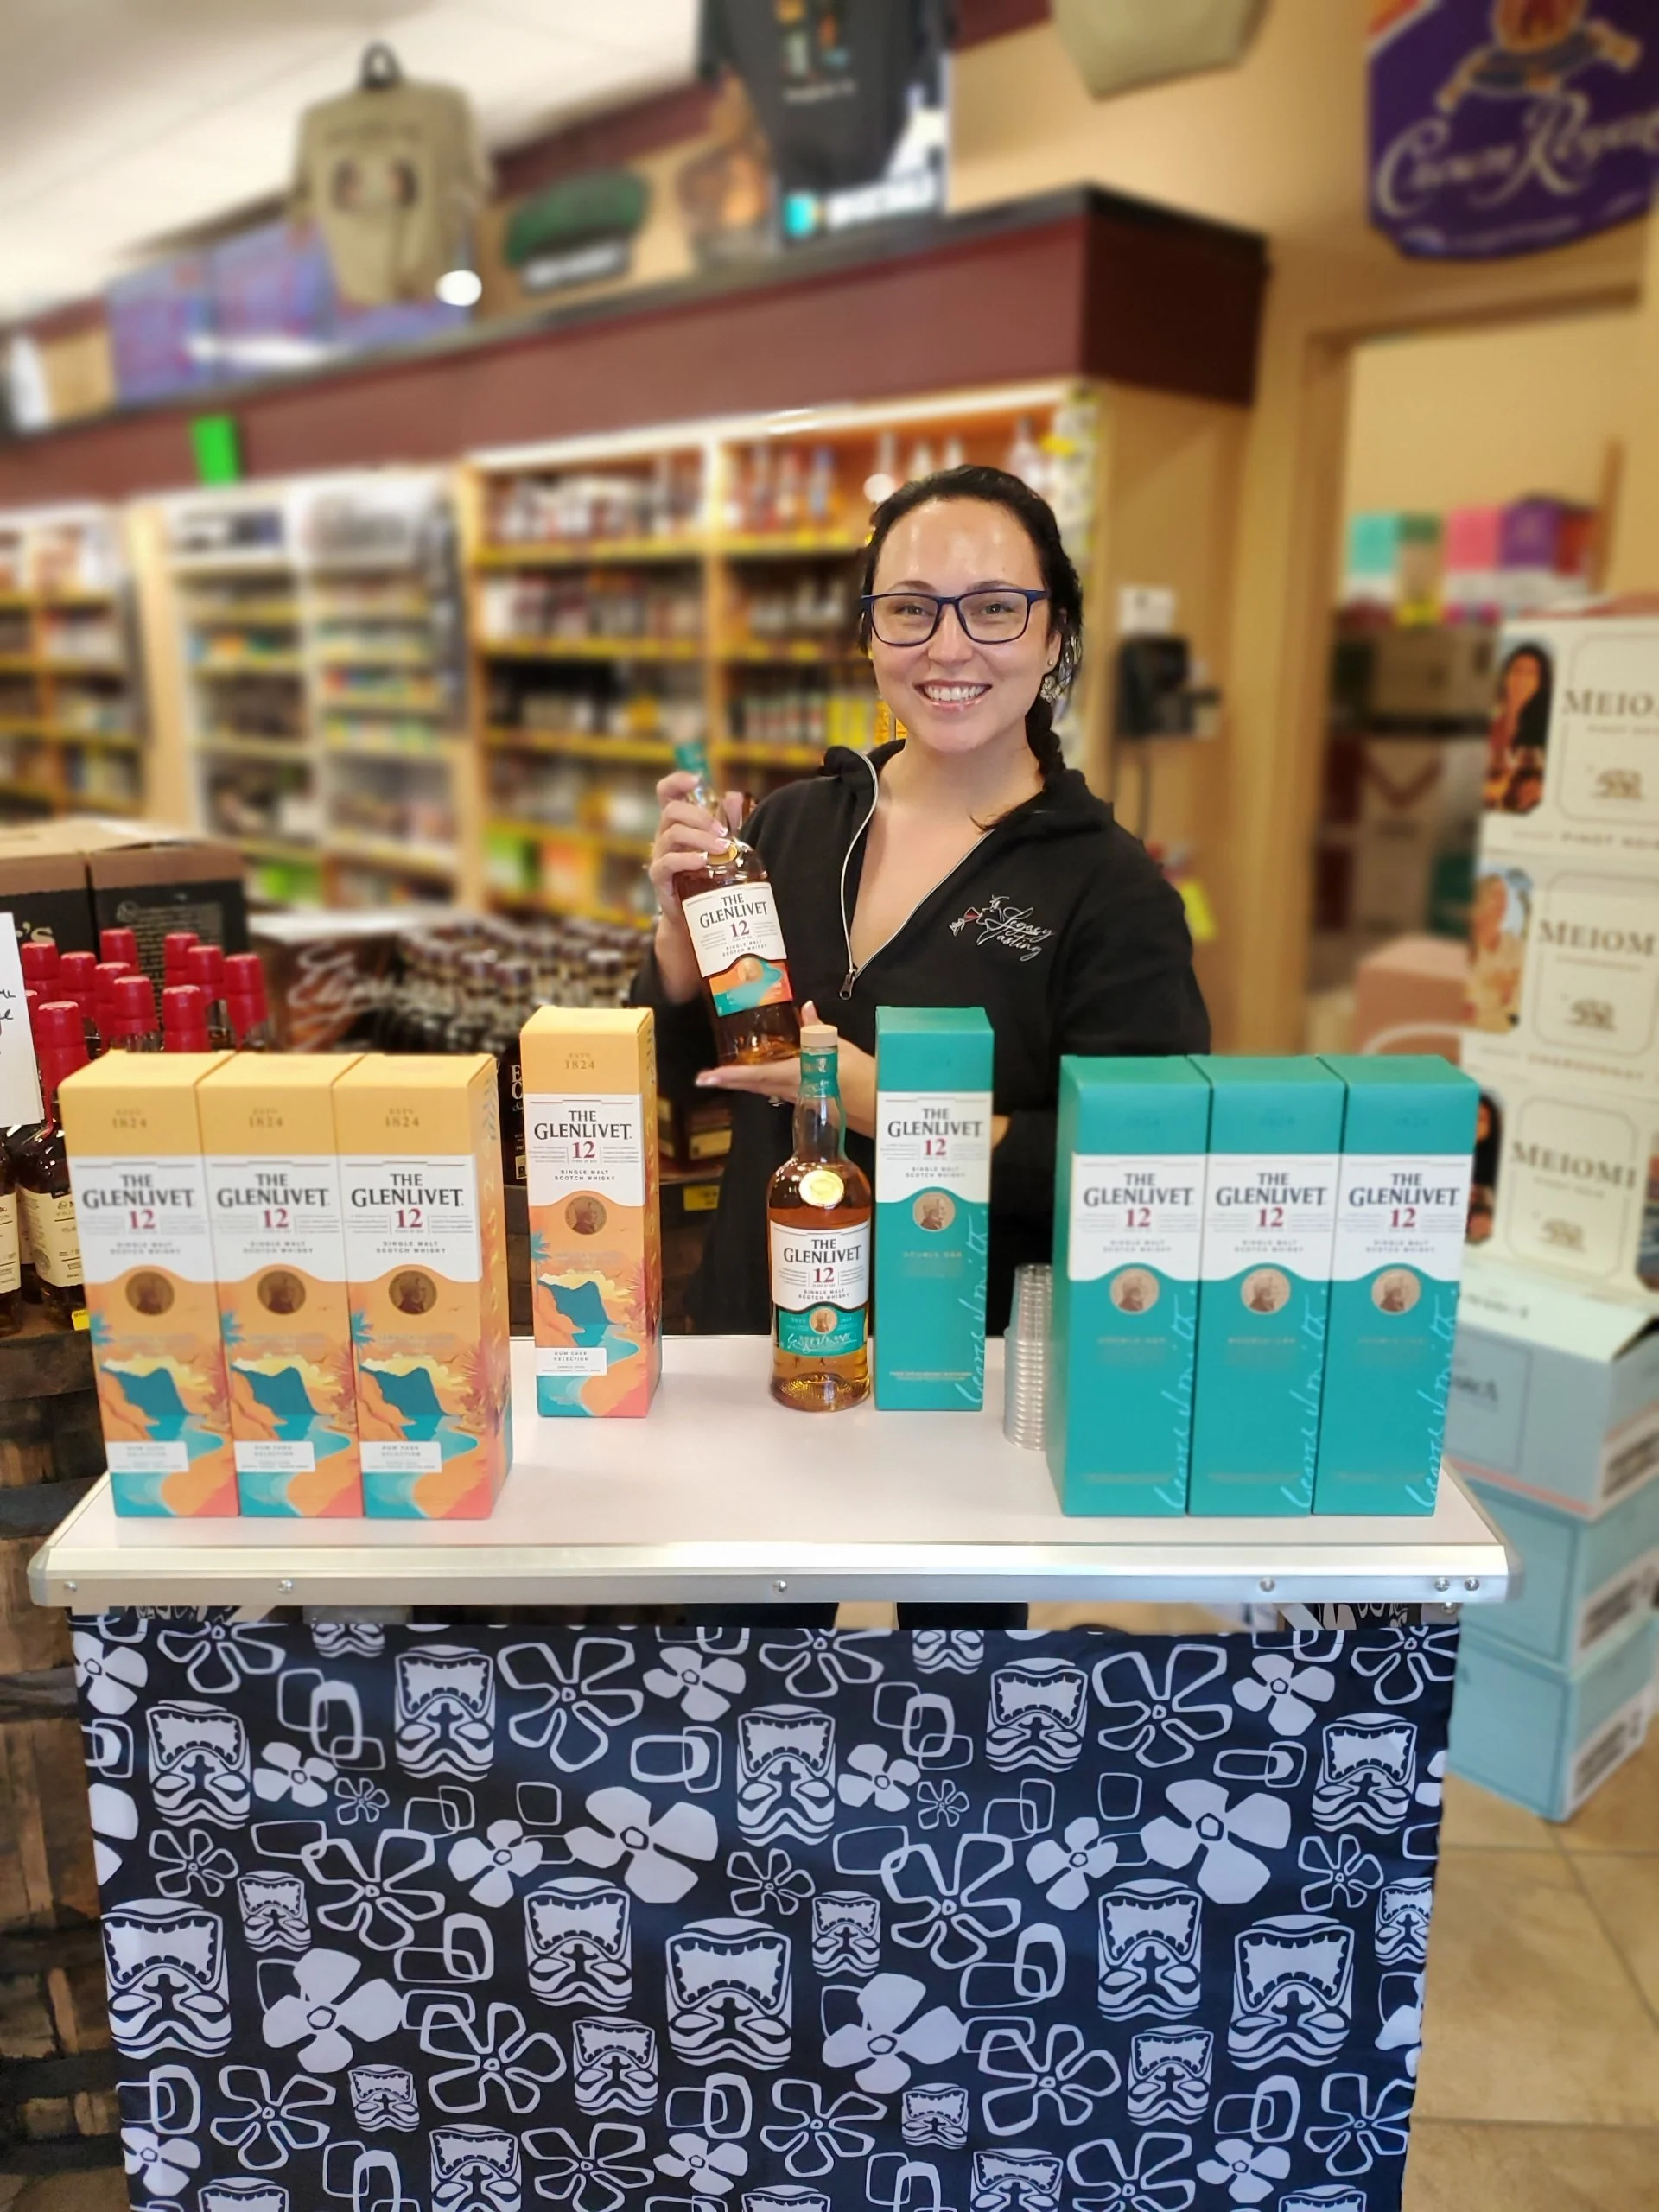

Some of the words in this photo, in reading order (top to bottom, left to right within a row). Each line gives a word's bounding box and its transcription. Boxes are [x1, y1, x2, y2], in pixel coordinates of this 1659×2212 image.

[721, 893, 744, 906] THE
[700, 901, 767, 928] GLENLIVET
[730, 920, 750, 938] 12
[1540, 919, 1655, 957] MEIOM
[565, 1059, 595, 1070] 1824
[568, 1110, 596, 1122] THE
[922, 1109, 949, 1119] THE
[572, 1141, 595, 1159] 12
[925, 1138, 947, 1156] 12
[1514, 1141, 1637, 1190] MEIOMI
[120, 1174, 152, 1187] THE
[256, 1173, 288, 1186] THE
[390, 1173, 423, 1186] THE
[1124, 1173, 1156, 1186] THE
[1257, 1173, 1289, 1185] THE
[1391, 1173, 1422, 1186] THE
[130, 1210, 156, 1229] 12
[263, 1208, 289, 1228] 12
[395, 1208, 423, 1229] 12
[1126, 1207, 1151, 1228] 12
[1258, 1206, 1284, 1228] 12
[1391, 1207, 1416, 1228] 12
[811, 1239, 836, 1249] THE
[784, 1245, 861, 1263] GLENLIVET
[813, 1267, 835, 1283] 12
